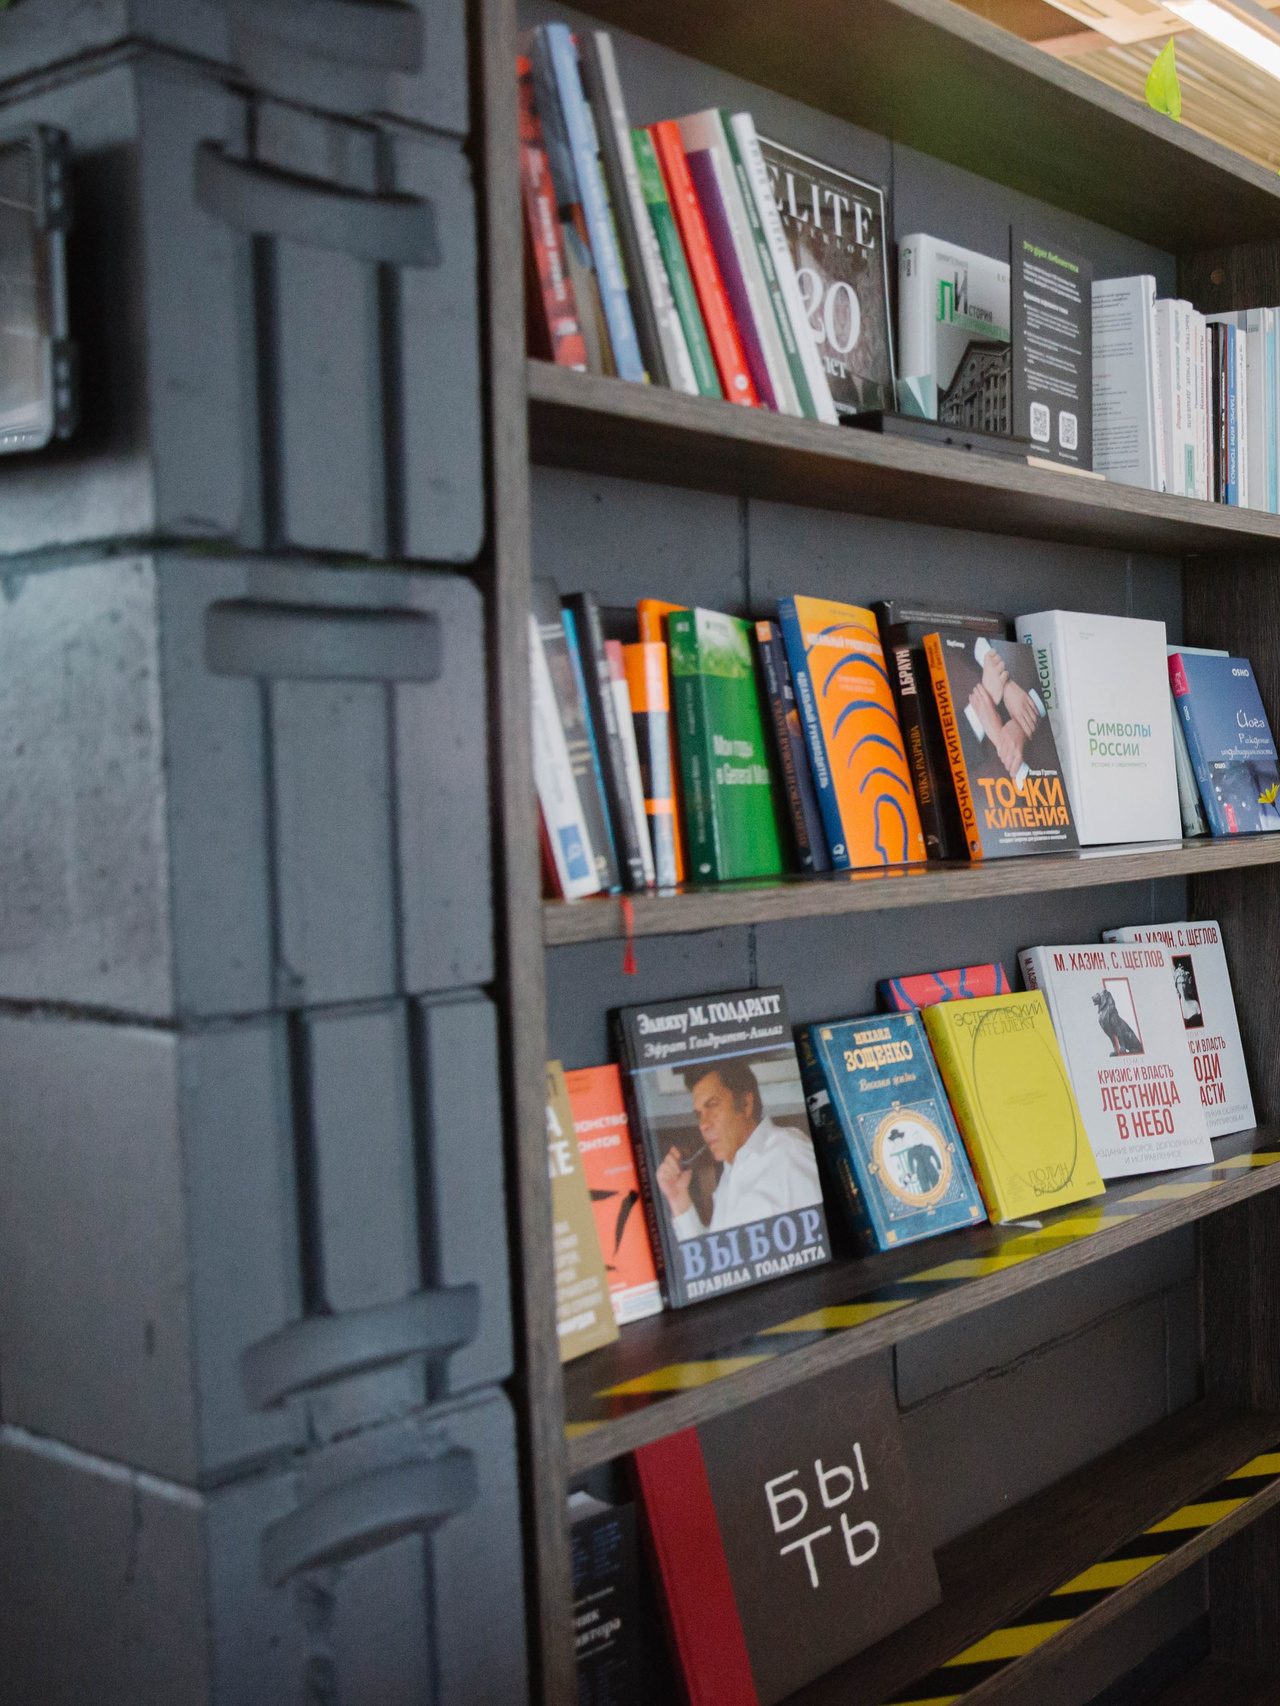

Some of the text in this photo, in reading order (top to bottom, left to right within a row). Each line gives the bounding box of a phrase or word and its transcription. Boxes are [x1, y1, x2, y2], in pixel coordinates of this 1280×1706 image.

[797, 268, 861, 354] 20
[896, 648, 917, 696] Д.БРАУН
[1038, 649, 1052, 711] РОССИИ
[1232, 668, 1249, 677] OSHO
[1087, 718, 1151, 737] Символы
[1236, 709, 1265, 728] Йога
[935, 680, 975, 830] ТОЧКИ КИПЕНИЯ
[1089, 738, 1140, 756] России
[977, 777, 1065, 807] ТОЧКИ
[984, 806, 1069, 829] КИПЕНИЯ
[1178, 930, 1187, 946] С.
[1187, 927, 1218, 947] ЩЕГЛОВ
[1053, 950, 1165, 973] М. ХАЗИН, С. ЩЕГЛОВ
[637, 995, 781, 1035] Элияху М. ГОЛДРАТТ
[953, 1000, 1044, 1027] ЭСТЕТИЧЕСКИЙ
[853, 1027, 892, 1046] МИХАИЛ
[967, 1015, 1036, 1039] ИНТЕЛЛЕКТ
[843, 1040, 914, 1072] ЗОЩЕНКО
[1201, 1036, 1226, 1052] ВЛАСТЬ
[1097, 1064, 1174, 1084] КРИЗИС И ВЛАСТЬ
[1099, 1079, 1181, 1112] ЛЕСТНИЦА
[1116, 1108, 1175, 1140] В НЕБО
[1094, 1145, 1128, 1158] ИЗДАНИЕ
[1028, 1163, 1069, 1184] ПОЛИН
[1034, 1177, 1073, 1198] БРАУН
[681, 1209, 823, 1280] ВЫБОР.
[686, 1246, 826, 1300] ПРАВИЛА ГОЛДРАТТА
[764, 1442, 869, 1533] БЫ
[779, 1512, 880, 1588] ТЬ
